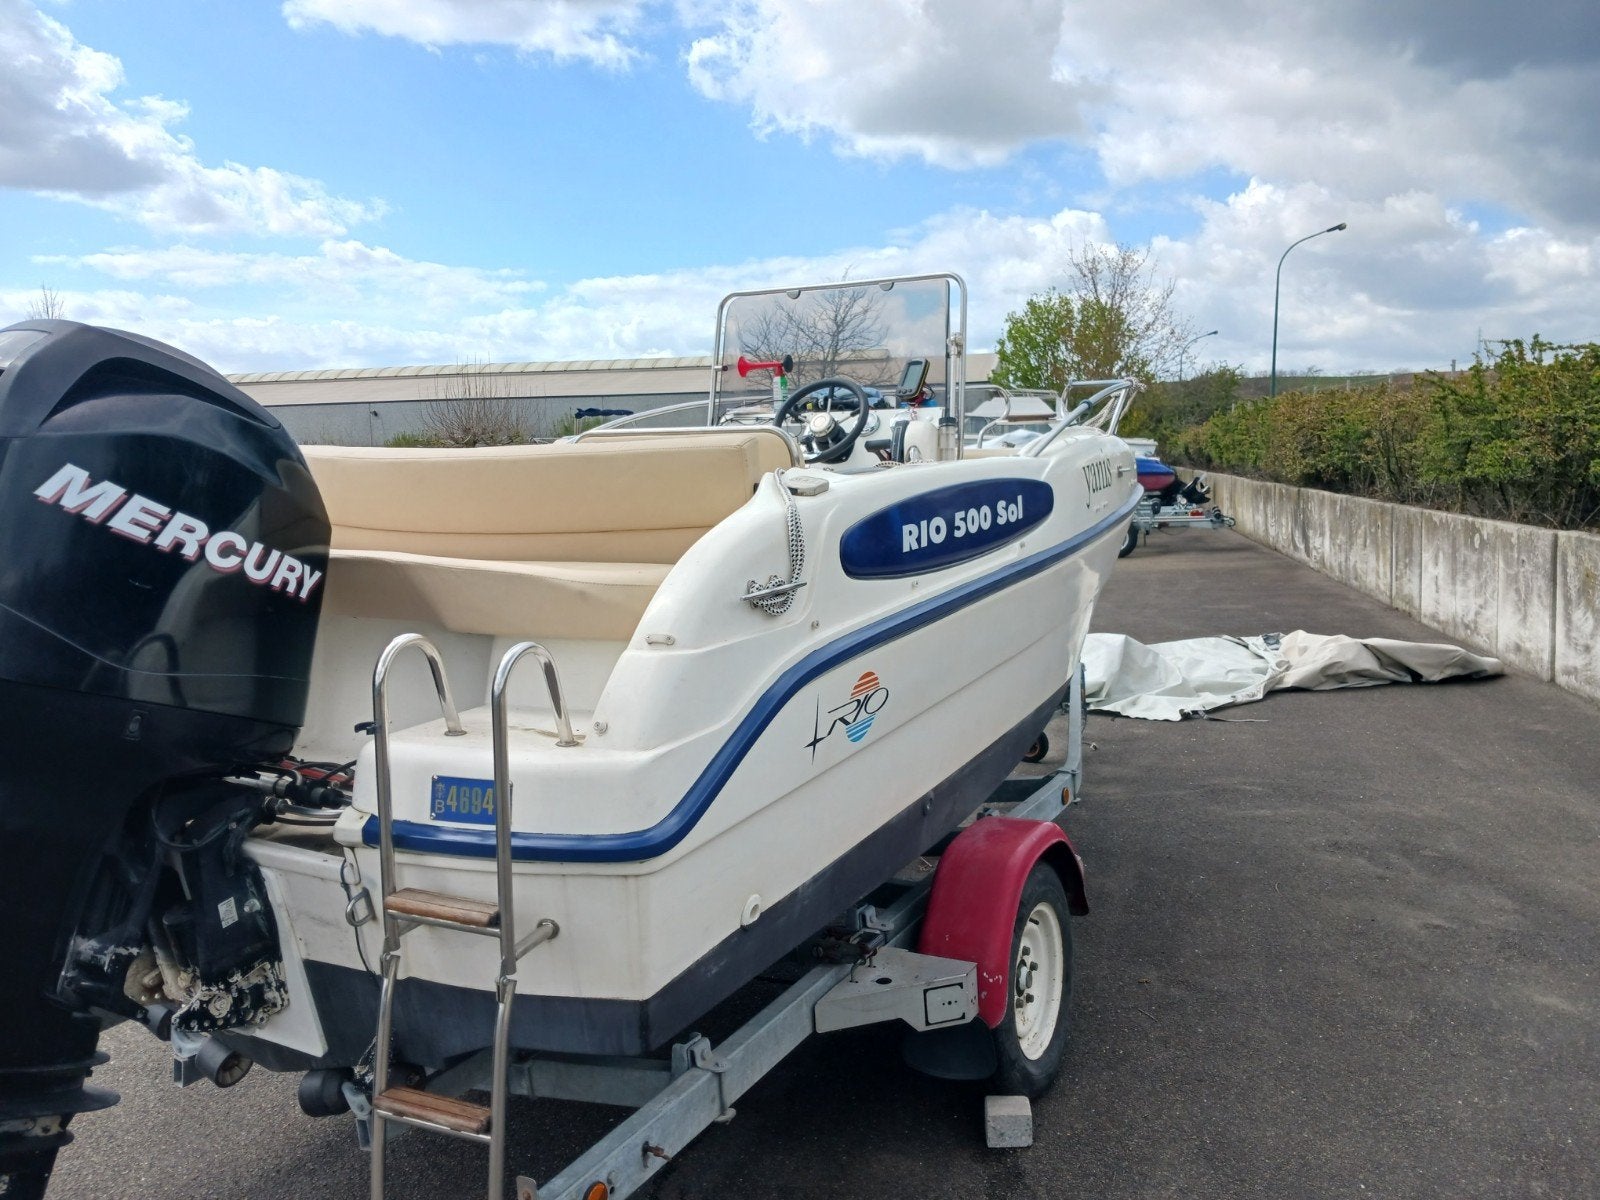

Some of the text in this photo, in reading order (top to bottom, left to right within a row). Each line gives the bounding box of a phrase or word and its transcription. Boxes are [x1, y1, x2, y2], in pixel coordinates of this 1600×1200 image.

[33, 462, 322, 603] MERCURY
[902, 494, 1024, 553] RIO 500 Sol
